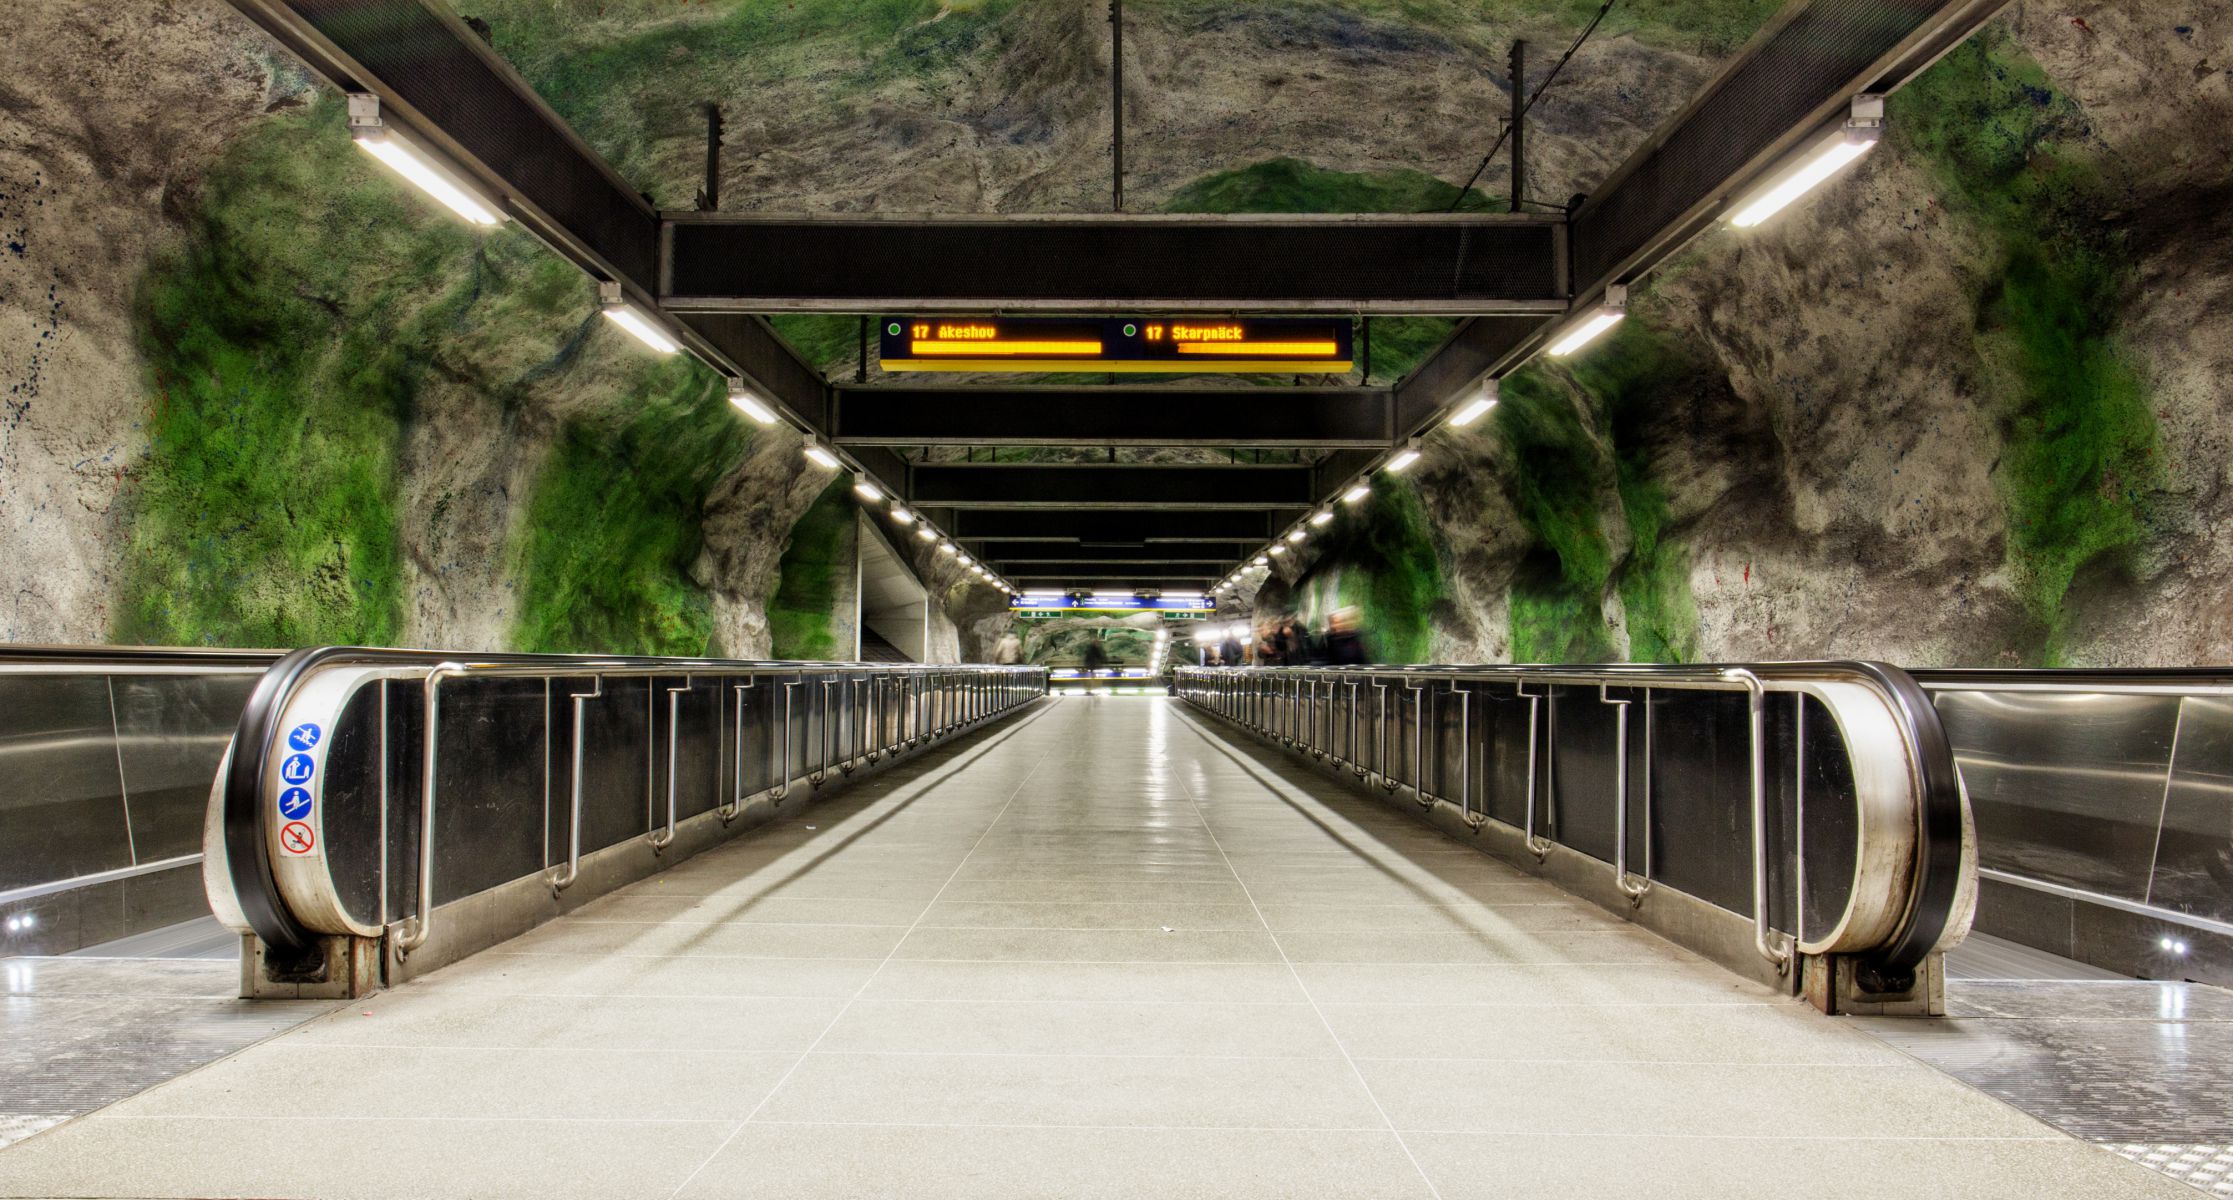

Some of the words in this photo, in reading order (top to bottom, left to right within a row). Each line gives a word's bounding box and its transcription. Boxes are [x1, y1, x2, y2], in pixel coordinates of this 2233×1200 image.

[912, 324, 929, 339] 17
[1145, 325, 1163, 340] 17
[1172, 325, 1243, 342] Skarpnäck
